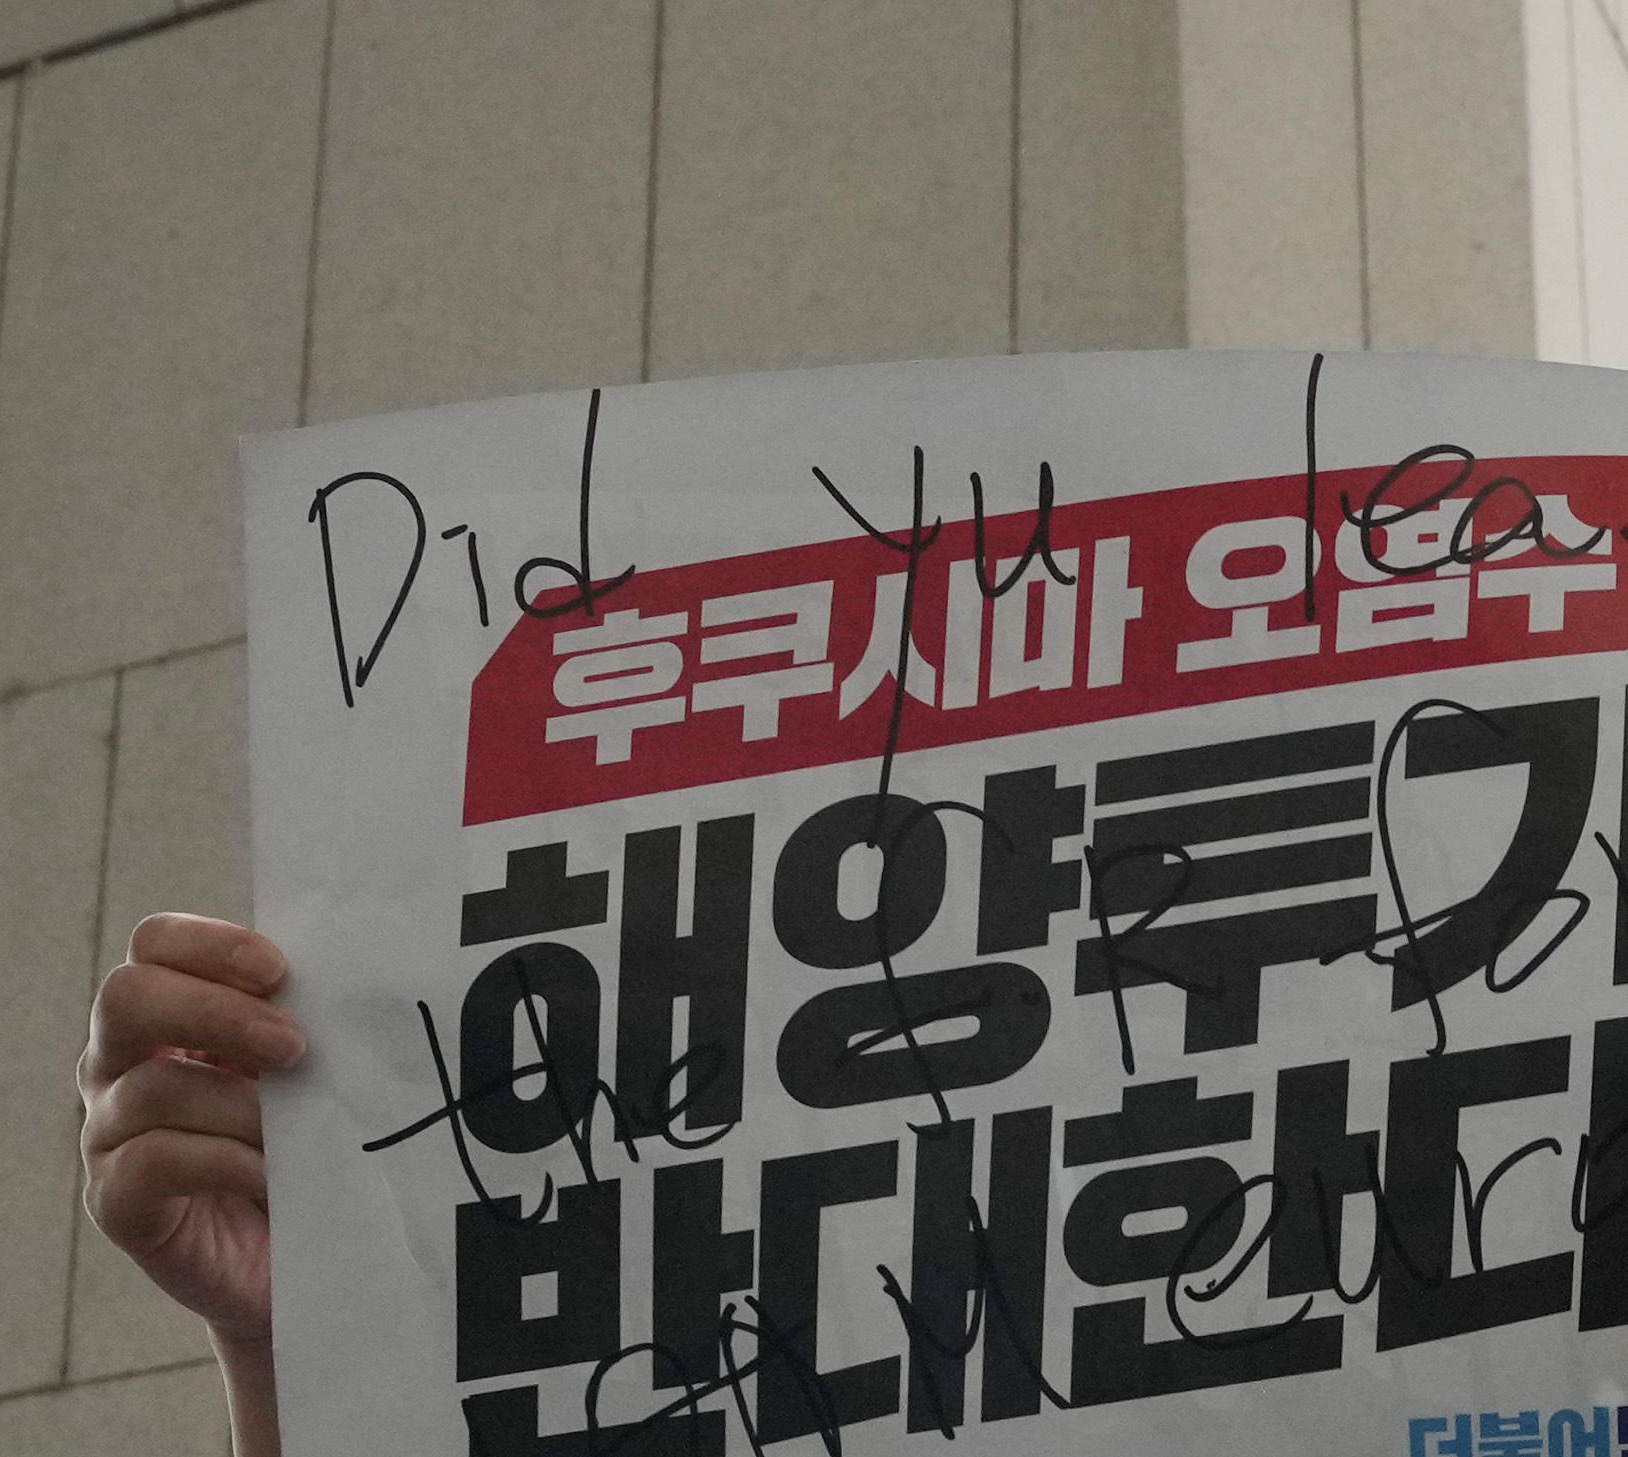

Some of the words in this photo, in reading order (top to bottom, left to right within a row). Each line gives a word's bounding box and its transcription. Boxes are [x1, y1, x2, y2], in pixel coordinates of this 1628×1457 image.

[308, 387, 636, 708] Did
[545, 535, 1144, 767] 후쿠시마
[1175, 494, 1618, 674] 오염수
